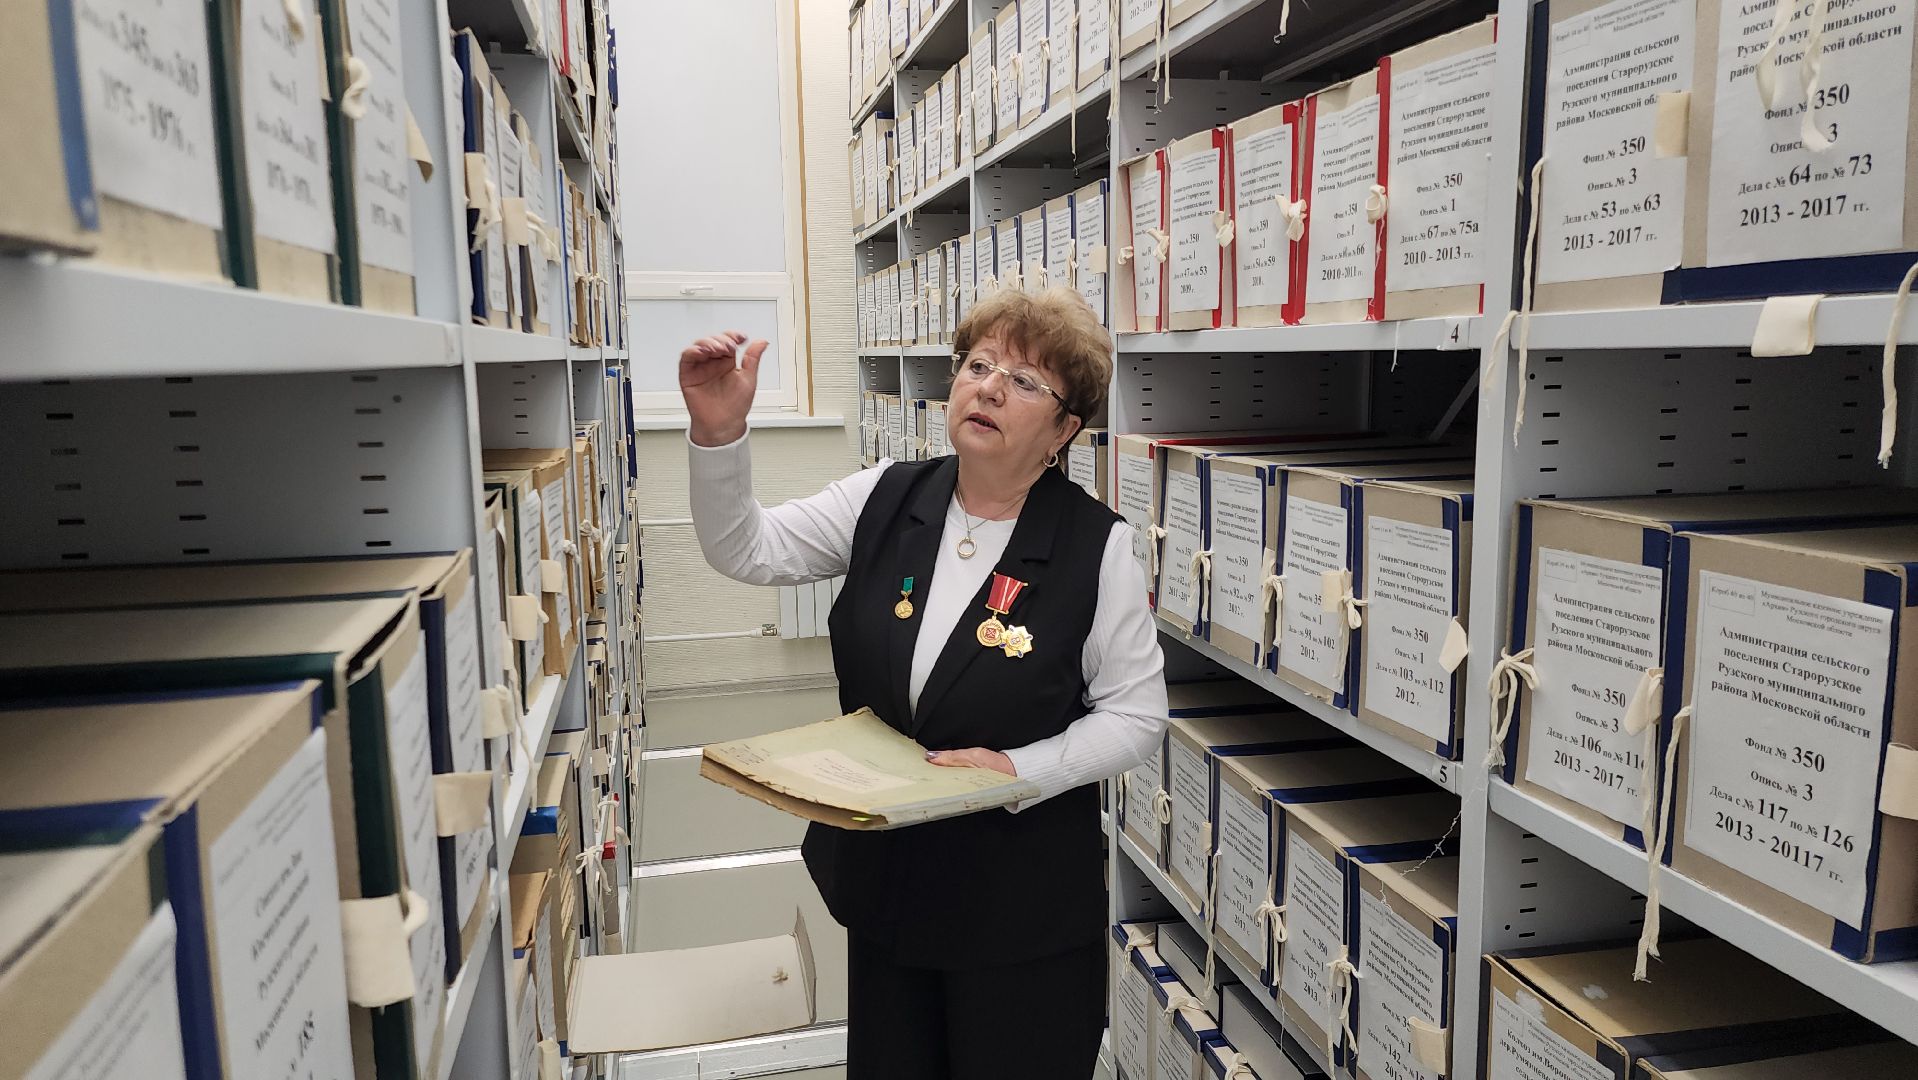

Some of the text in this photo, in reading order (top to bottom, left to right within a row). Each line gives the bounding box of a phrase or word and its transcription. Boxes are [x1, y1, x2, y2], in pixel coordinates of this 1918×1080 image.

[1848, 24, 1903, 48] области
[1563, 34, 1680, 78] Администрация сельского
[1566, 55, 1674, 94] поселения Старорузское
[1561, 95, 1598, 112] Рузского
[1600, 73, 1678, 101] муниципального
[1765, 109, 1793, 120] Фонд
[1814, 83, 1850, 110] 350
[1556, 99, 1641, 131] района Московской
[1827, 122, 1838, 143] 3
[1582, 154, 1604, 164] Фонд
[1620, 136, 1646, 157] 350
[1442, 172, 1463, 189] 350
[1587, 181, 1614, 192] Опись
[1628, 167, 1637, 185] 3
[1738, 183, 1763, 196] Дела
[1773, 176, 1786, 189] №
[1789, 163, 1812, 186] 64
[1814, 171, 1828, 182] по
[1831, 166, 1845, 179] №
[1848, 153, 1872, 176] 73
[1451, 198, 1456, 212] 1
[1601, 200, 1617, 219] 53
[1643, 193, 1661, 212] 63
[1740, 203, 1781, 227] 2013
[1800, 194, 1847, 219] 2017
[1853, 201, 1870, 213] гг.
[1427, 225, 1439, 239] 67
[1563, 233, 1594, 252] 2013
[1607, 226, 1642, 246] 2017
[1403, 250, 1426, 266] 2010
[1436, 246, 1461, 261] 2013
[1450, 324, 1459, 343] 4
[1555, 610, 1651, 641] поселения Старорузское
[1614, 607, 1655, 625] сельского
[1413, 627, 1429, 644] 350
[1586, 633, 1653, 658] муниципального
[1420, 652, 1424, 664] 1
[1547, 638, 1648, 673] района Московской облас
[1719, 626, 1870, 677] Администрация сельского
[1399, 666, 1444, 694] 103 112
[1724, 647, 1862, 695] поселения Старорузское
[1395, 686, 1415, 705] 2012
[1571, 683, 1591, 697] Фонд
[1603, 687, 1626, 708] 350
[1718, 662, 1865, 717] Рузского муниципального
[1575, 711, 1598, 727] Опись
[1612, 718, 1619, 734] 3
[1711, 679, 1870, 739] района Московской области
[1580, 734, 1602, 754] 106
[1744, 737, 1825, 772] Фонд № 350
[1439, 765, 1448, 784] 5
[1554, 749, 1581, 773] 2013
[1593, 765, 1624, 790] 2017
[1750, 770, 1813, 801] Опись № 3
[1709, 786, 1855, 853] Дела с № 117 по № 126
[1715, 811, 1754, 841] 2013
[1770, 835, 1824, 872] 20117
[1828, 870, 1843, 883] гг.
[1389, 1043, 1401, 1065] 142
